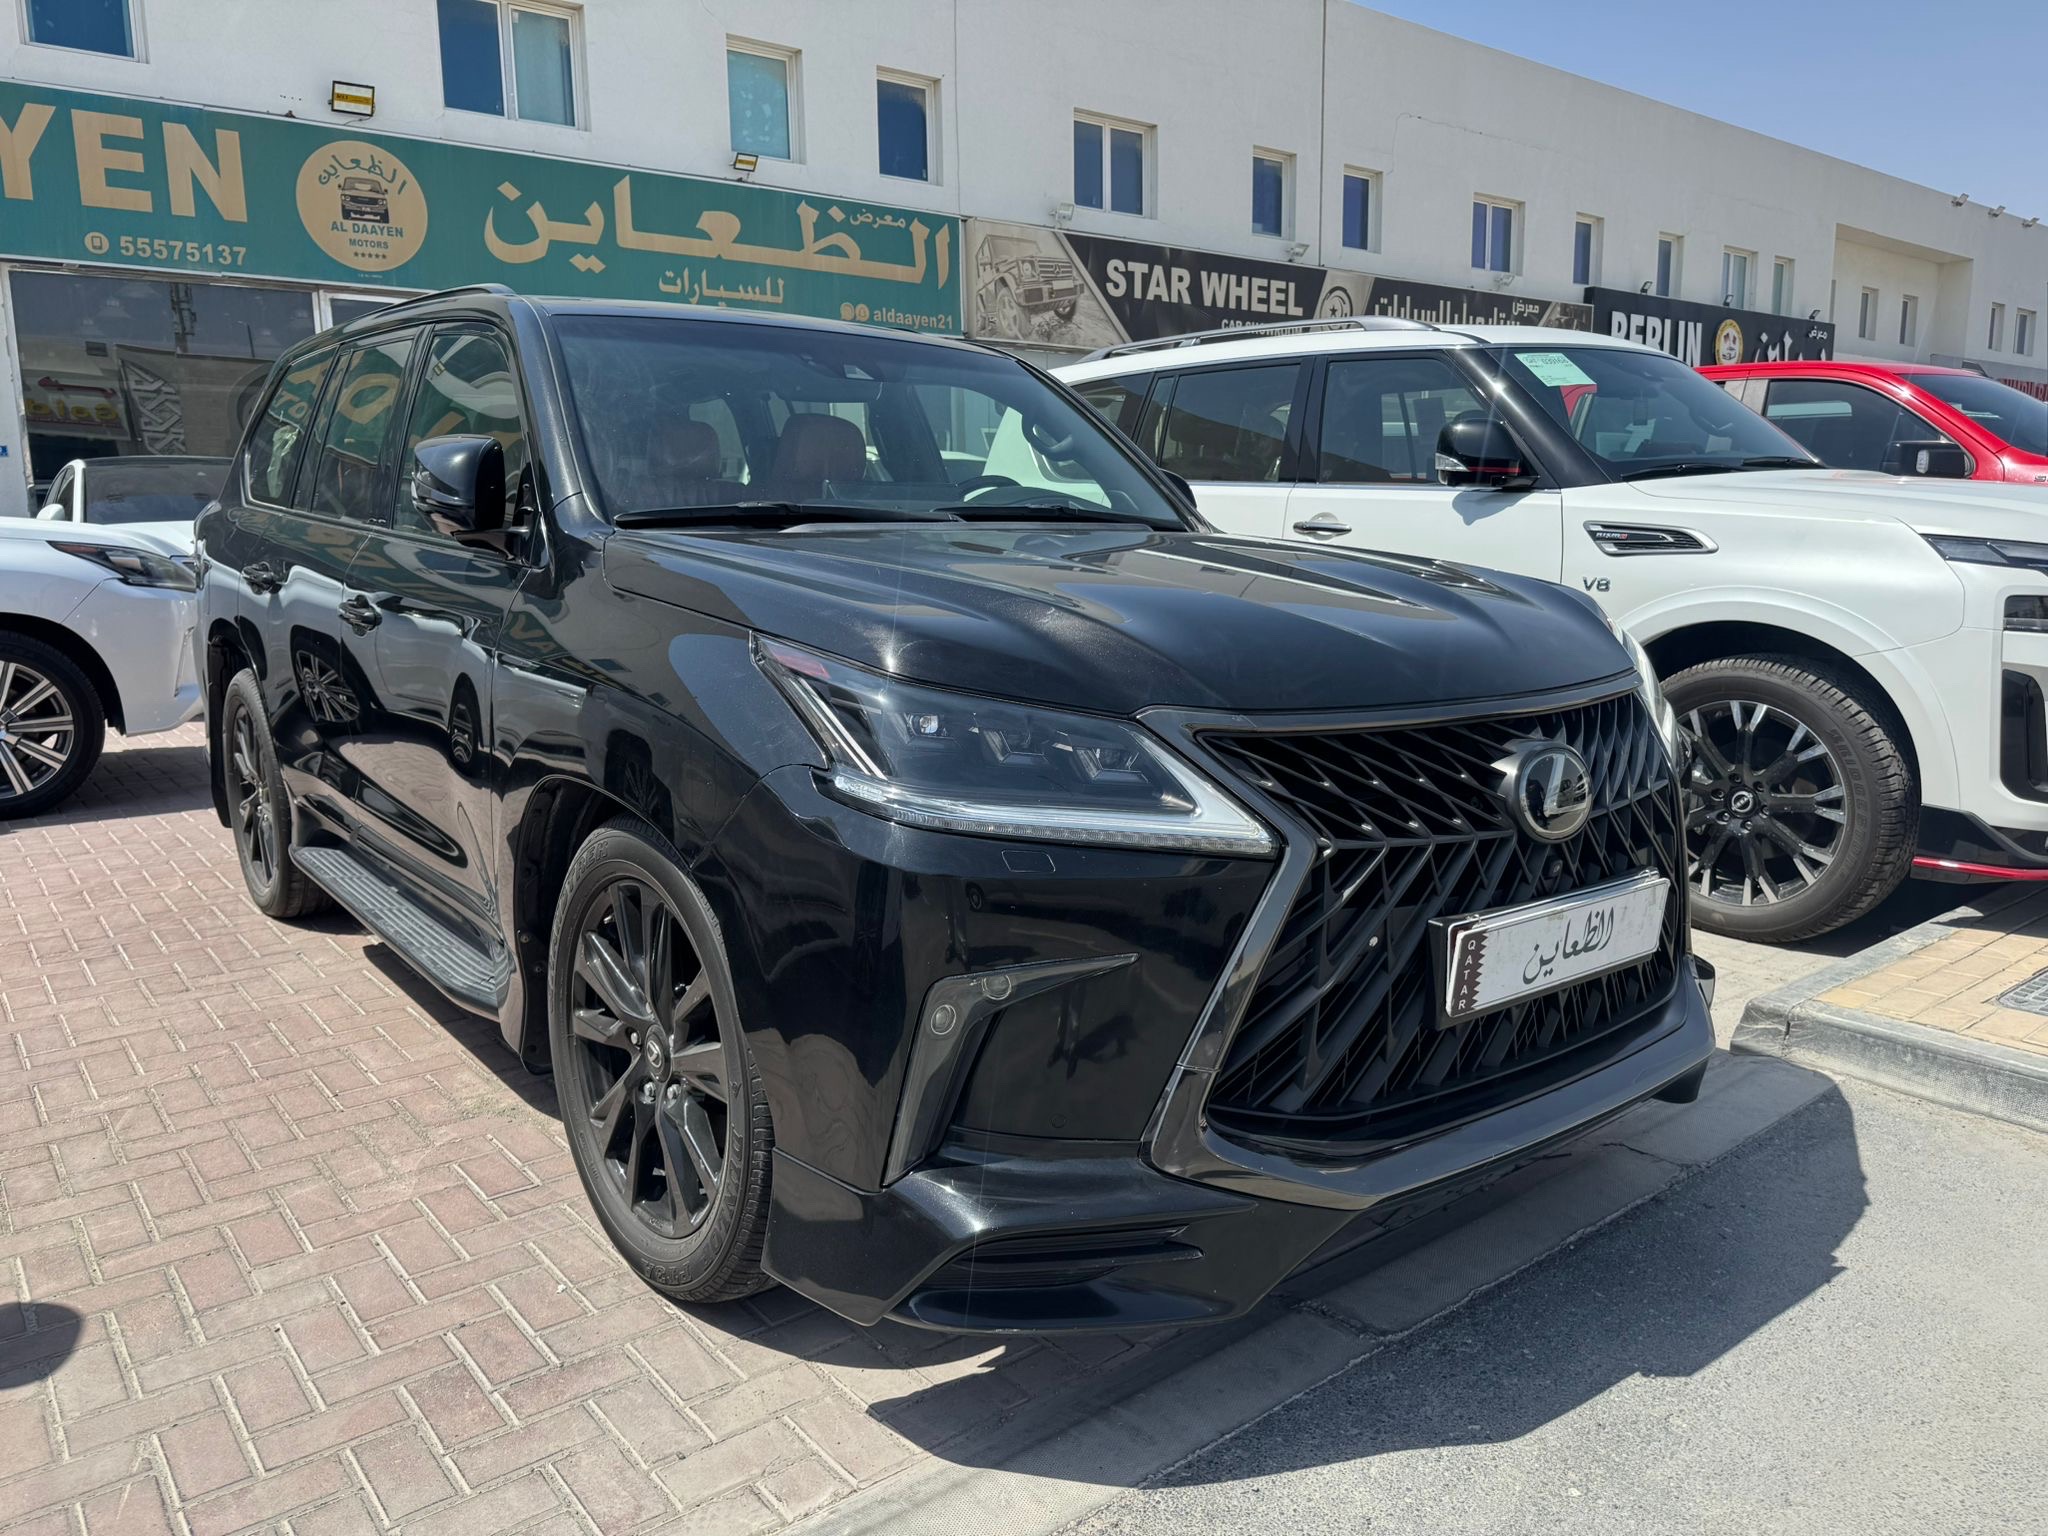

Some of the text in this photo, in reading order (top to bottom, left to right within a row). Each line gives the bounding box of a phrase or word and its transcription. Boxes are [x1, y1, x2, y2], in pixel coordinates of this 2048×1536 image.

[0, 102, 248, 223] YEN
[318, 154, 407, 195] الظعاين
[331, 220, 404, 238] AL DAAYEN
[483, 174, 951, 290] الظعاين
[848, 207, 907, 231] معرض
[119, 235, 248, 266] 55575137
[348, 238, 389, 250] MOTORS
[658, 267, 785, 307] للسيارات
[1105, 258, 1304, 317] STAR WHEEL
[873, 308, 954, 331] aldaayen21
[1512, 299, 1540, 317] معرض
[1582, 576, 1611, 592] V8
[1522, 906, 1615, 985] الظعاين
[1457, 939, 1476, 1010] QATAR
